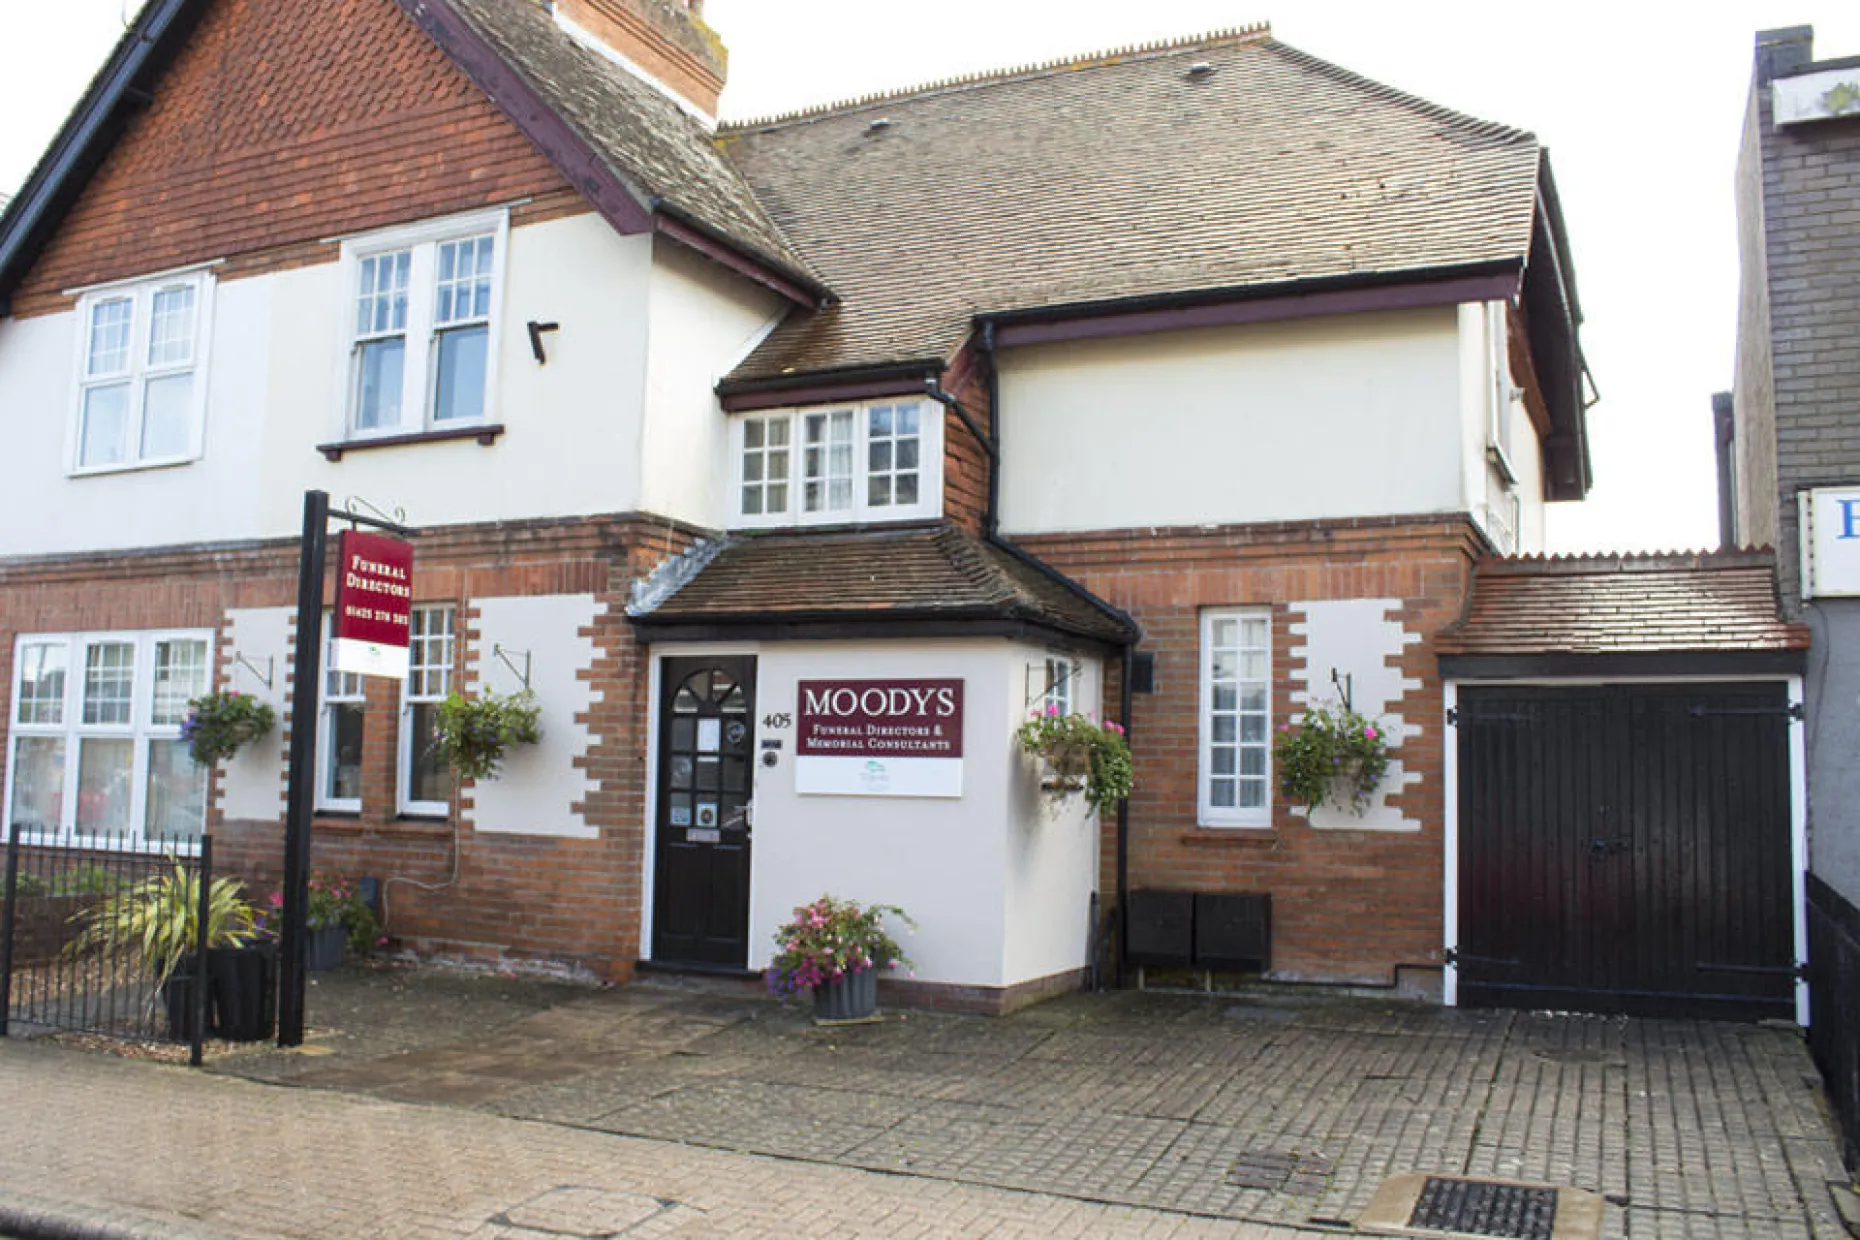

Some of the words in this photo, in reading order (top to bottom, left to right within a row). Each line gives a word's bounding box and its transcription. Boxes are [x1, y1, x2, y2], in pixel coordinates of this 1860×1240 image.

[804, 687, 955, 716] MOODYS
[762, 713, 792, 729] 405
[934, 725, 943, 736] &
